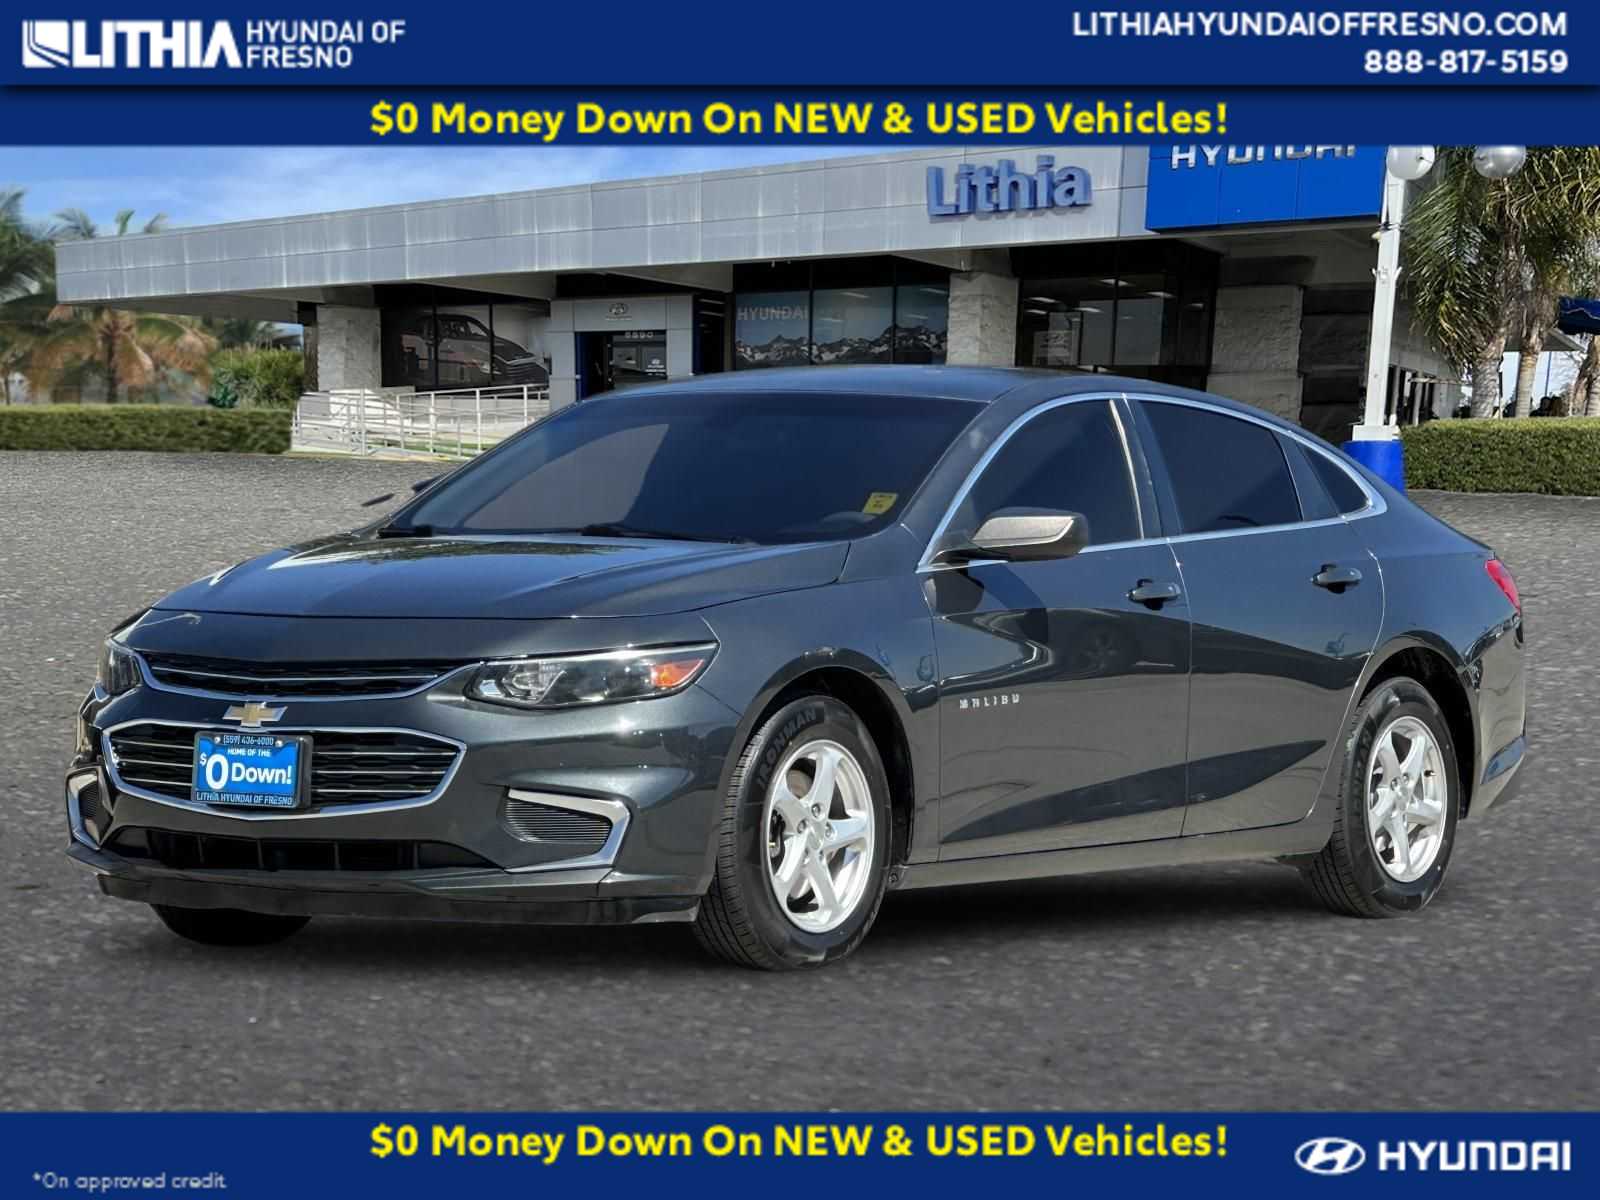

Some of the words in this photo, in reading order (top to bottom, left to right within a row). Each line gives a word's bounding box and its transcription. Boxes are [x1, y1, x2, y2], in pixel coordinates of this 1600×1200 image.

[926, 155, 1092, 217] Lithia
[737, 305, 809, 321] HYUNDAI
[959, 693, 1020, 709] MALIBU
[227, 748, 246, 756] HOME
[247, 749, 256, 757] OF
[258, 749, 272, 758] THE
[757, 706, 817, 788] IRONMAN
[231, 762, 292, 785] Down!
[220, 793, 252, 804] HYUNDAI
[253, 795, 263, 804] OF
[264, 795, 293, 806] FRESNO
